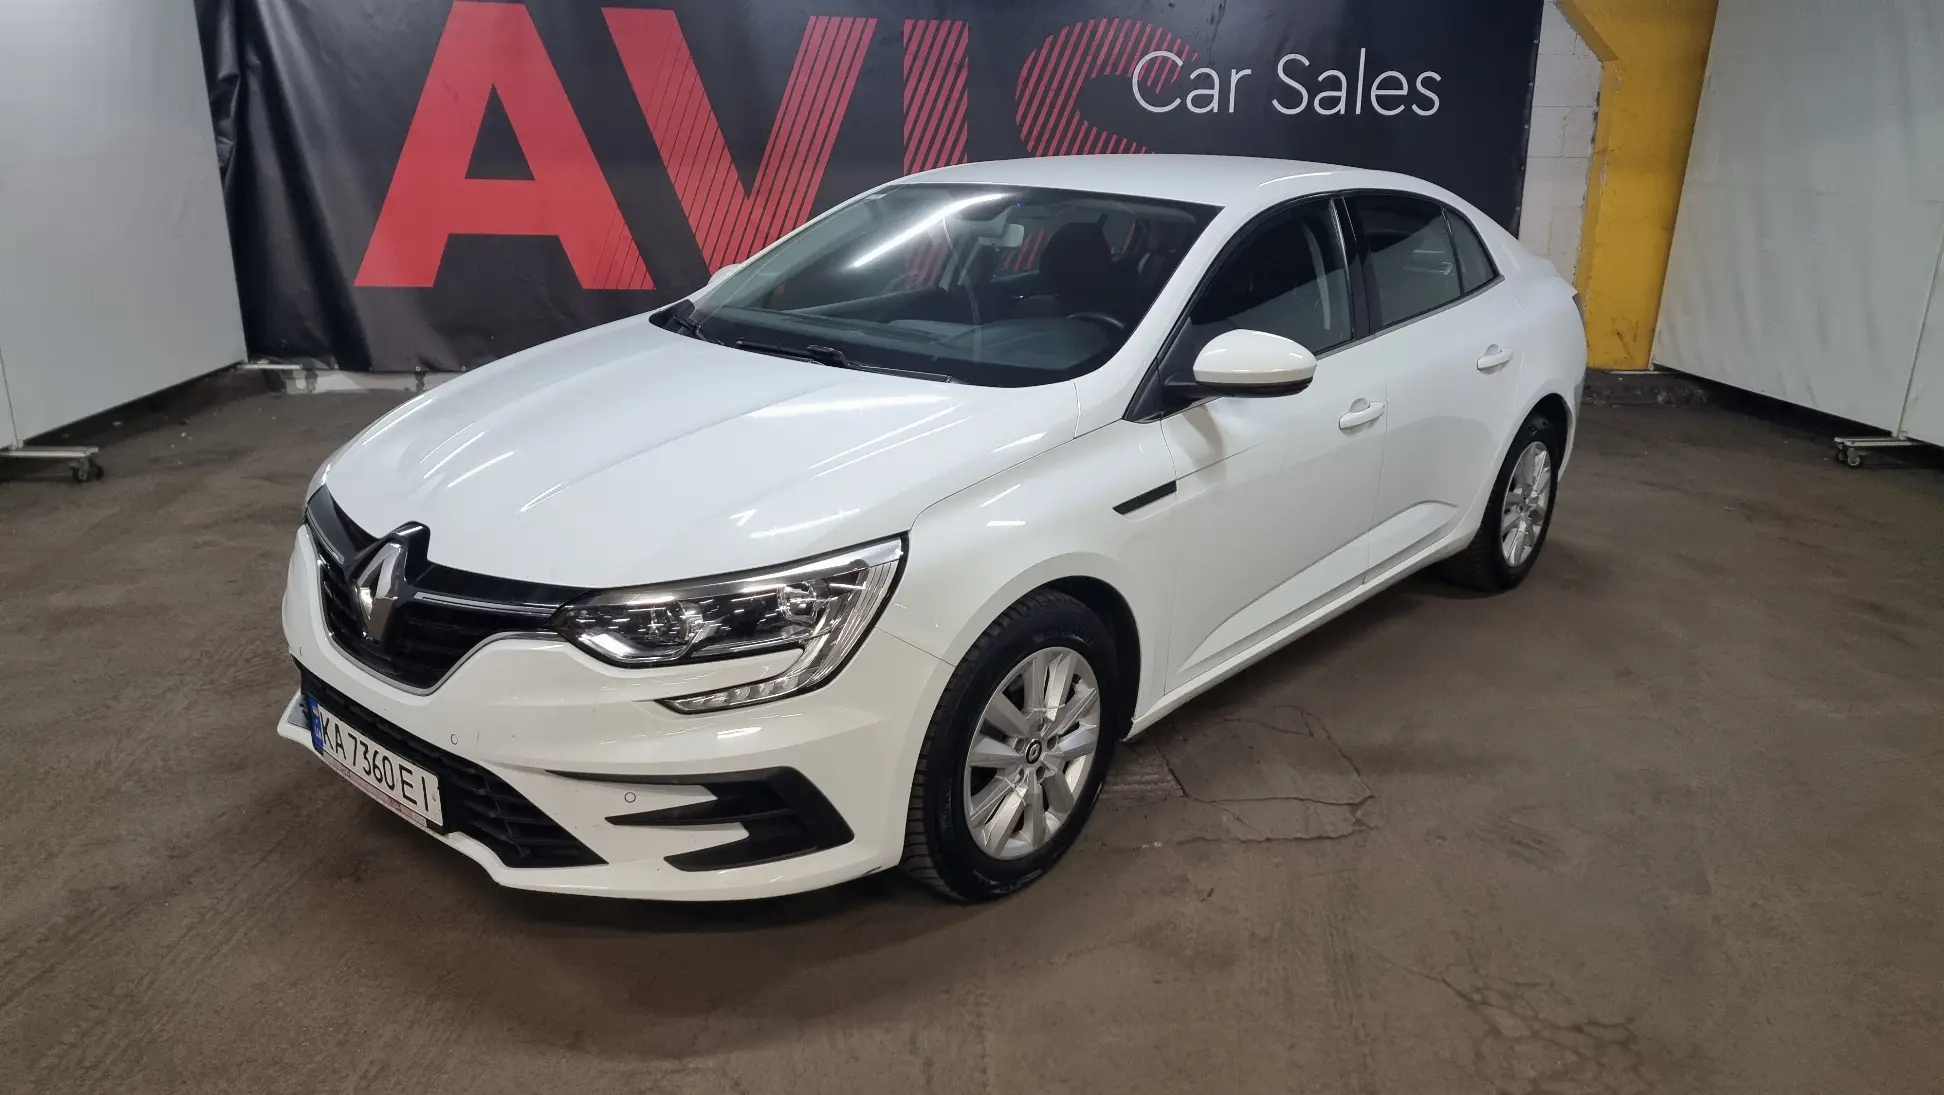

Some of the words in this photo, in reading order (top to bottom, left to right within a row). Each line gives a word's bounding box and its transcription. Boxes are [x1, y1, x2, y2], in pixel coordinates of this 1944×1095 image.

[1132, 50, 1251, 115] Car
[1272, 48, 1442, 117] Sales
[320, 711, 347, 760] KA
[348, 732, 395, 791] 7360
